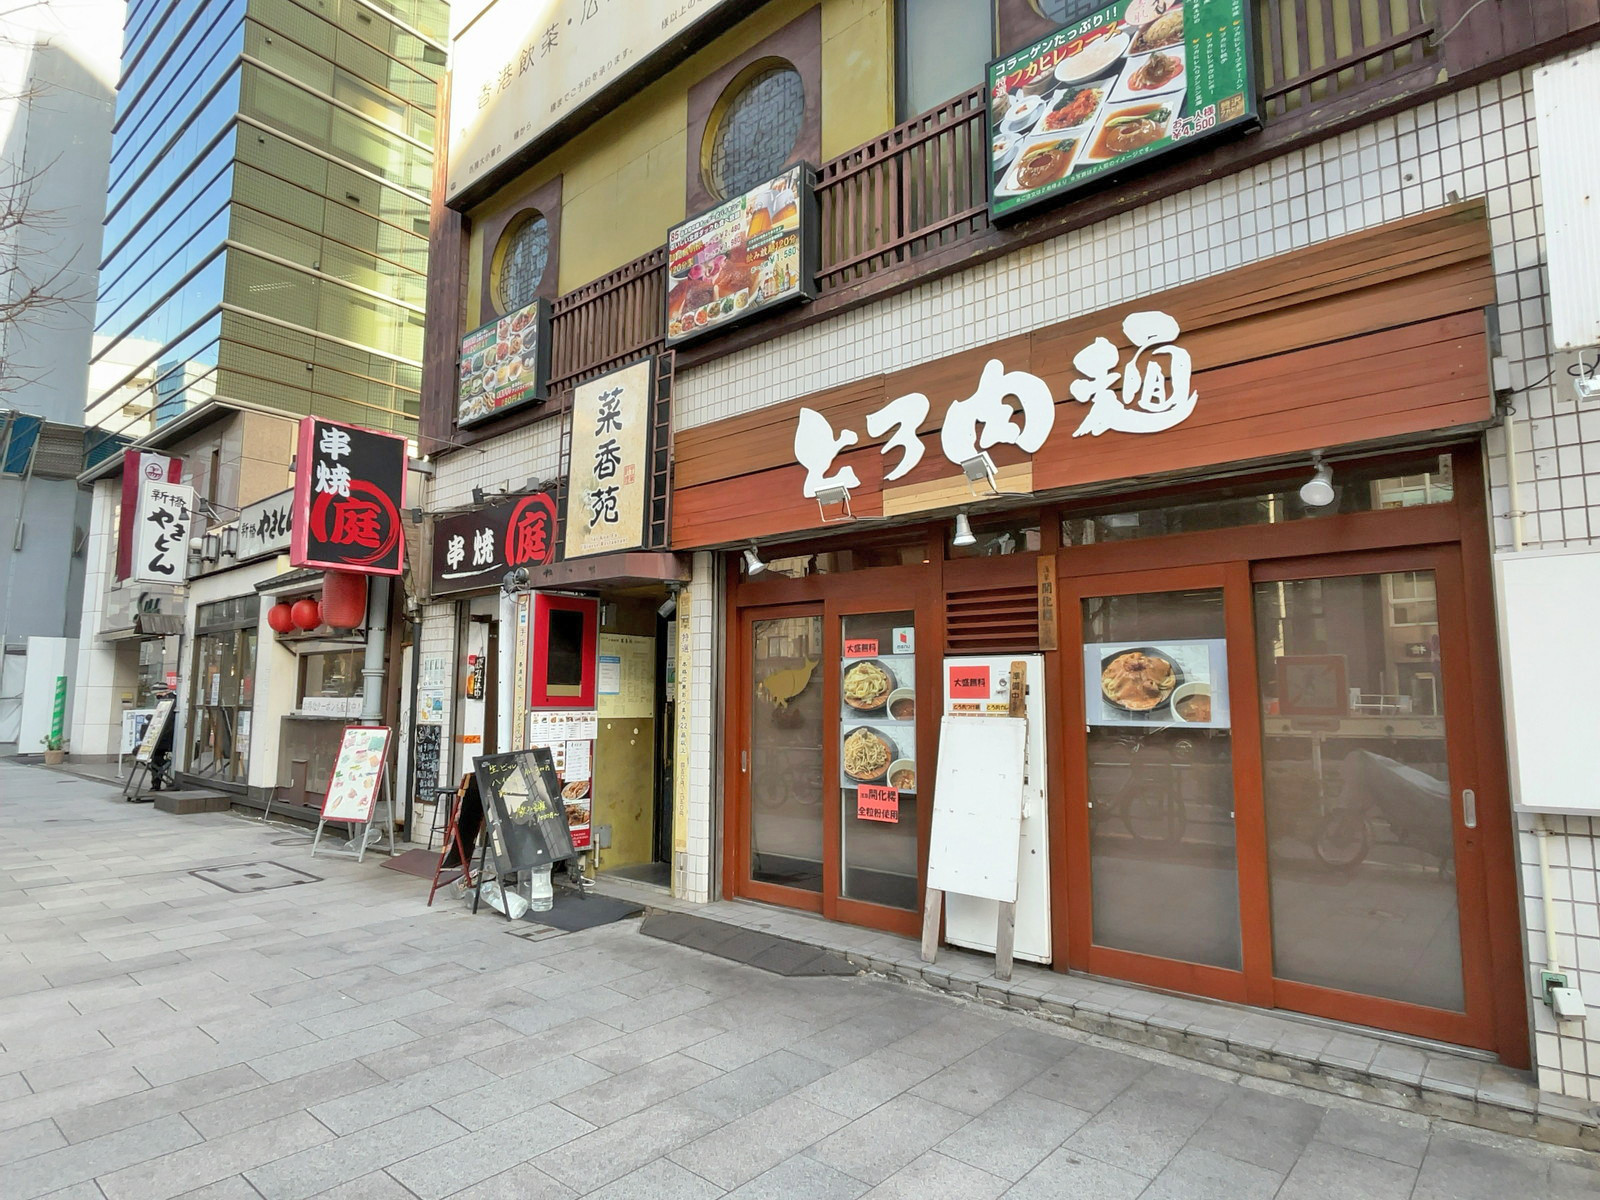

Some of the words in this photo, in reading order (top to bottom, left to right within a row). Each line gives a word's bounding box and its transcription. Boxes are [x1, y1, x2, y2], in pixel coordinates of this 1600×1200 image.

[1010, 21, 1123, 86] フカヒレコース
[995, 76, 1006, 98] 特選
[1172, 105, 1215, 130] お一人様
[315, 427, 351, 497] 串焼
[590, 387, 624, 527] 菜香苑
[151, 488, 186, 507] 新橋
[147, 507, 186, 575] やきとん
[330, 497, 382, 548] 庭
[446, 527, 495, 570] 串焼
[516, 511, 547, 565] 庭
[847, 643, 876, 653] 大盛無料
[954, 678, 985, 687] 大盛無料
[858, 806, 898, 820] 全粒粉使用
